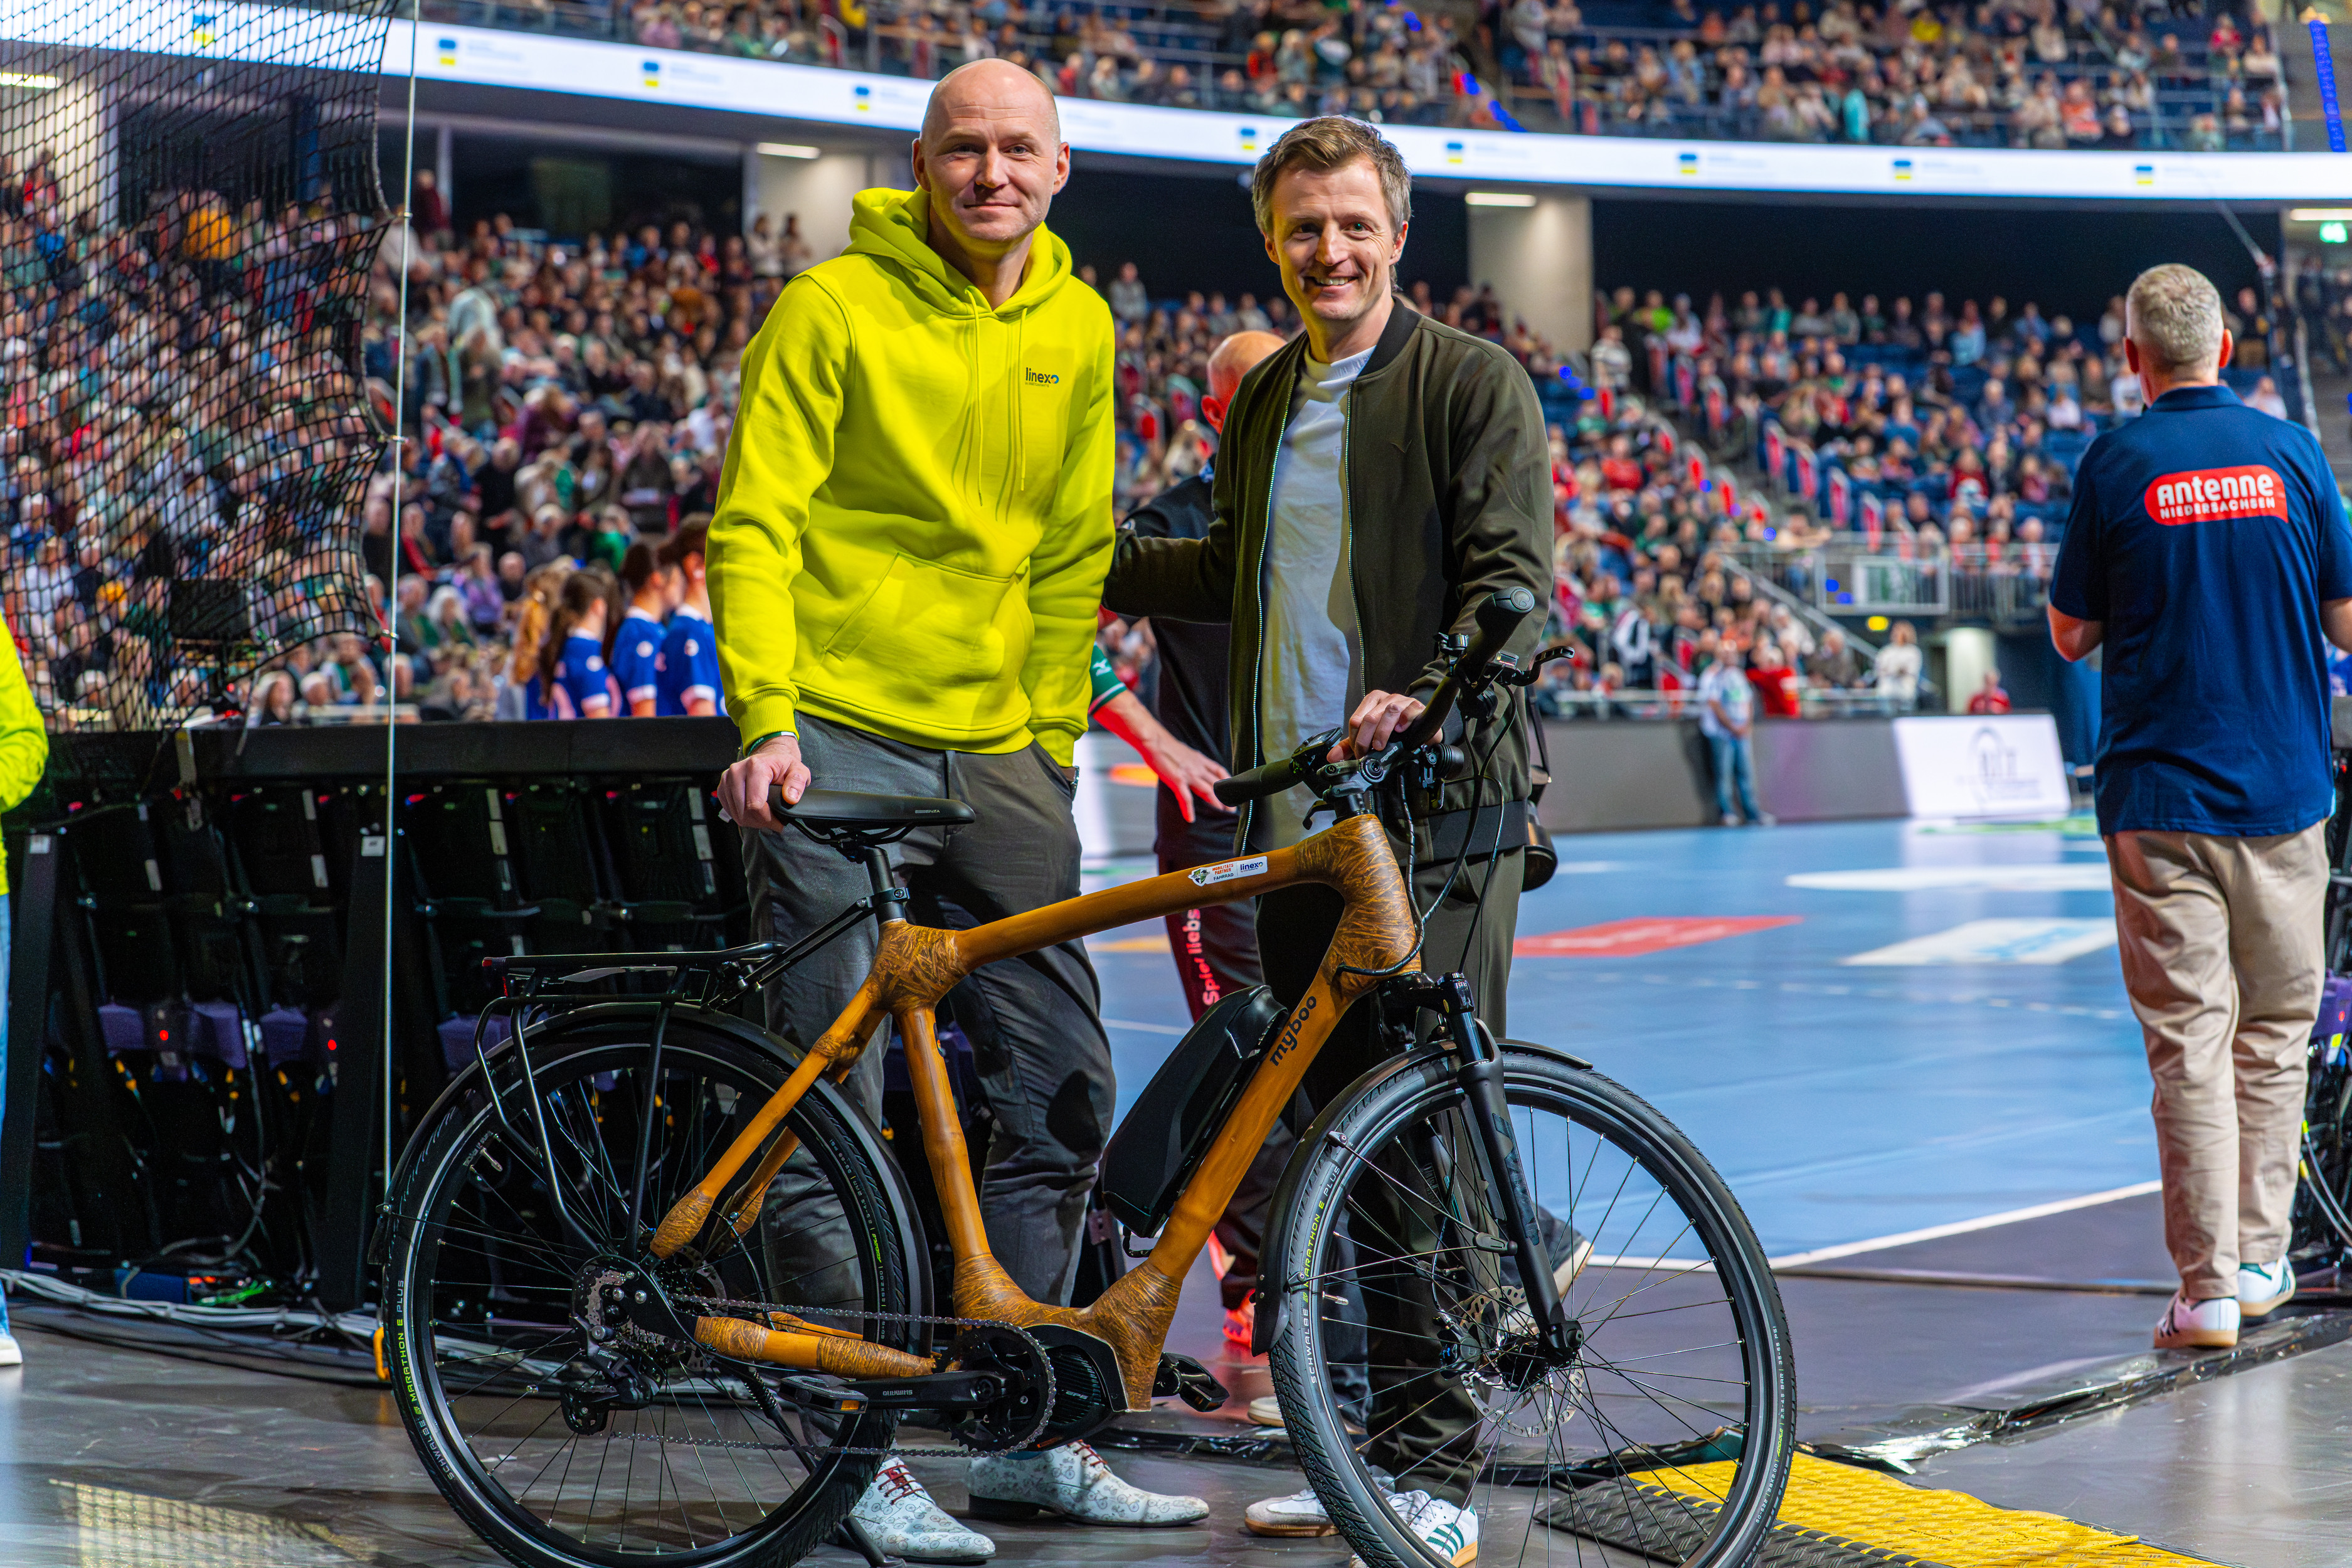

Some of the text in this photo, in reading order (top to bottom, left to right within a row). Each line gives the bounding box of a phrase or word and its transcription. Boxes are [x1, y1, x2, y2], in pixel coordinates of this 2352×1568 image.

[1025, 367, 1059, 384] linexo
[2159, 496, 2275, 519] NIEDERSACHSEN
[1240, 861, 1263, 871] linexo
[1269, 996, 1316, 1066] myboo
[396, 1280, 405, 1313] PLUS
[1303, 1308, 1318, 1384] SCHWALBE
[1318, 1200, 1325, 1210] E
[1323, 1166, 1340, 1197] PLUS
[398, 1333, 418, 1402] MARATHON
[418, 1419, 454, 1481] SCHWALBE
